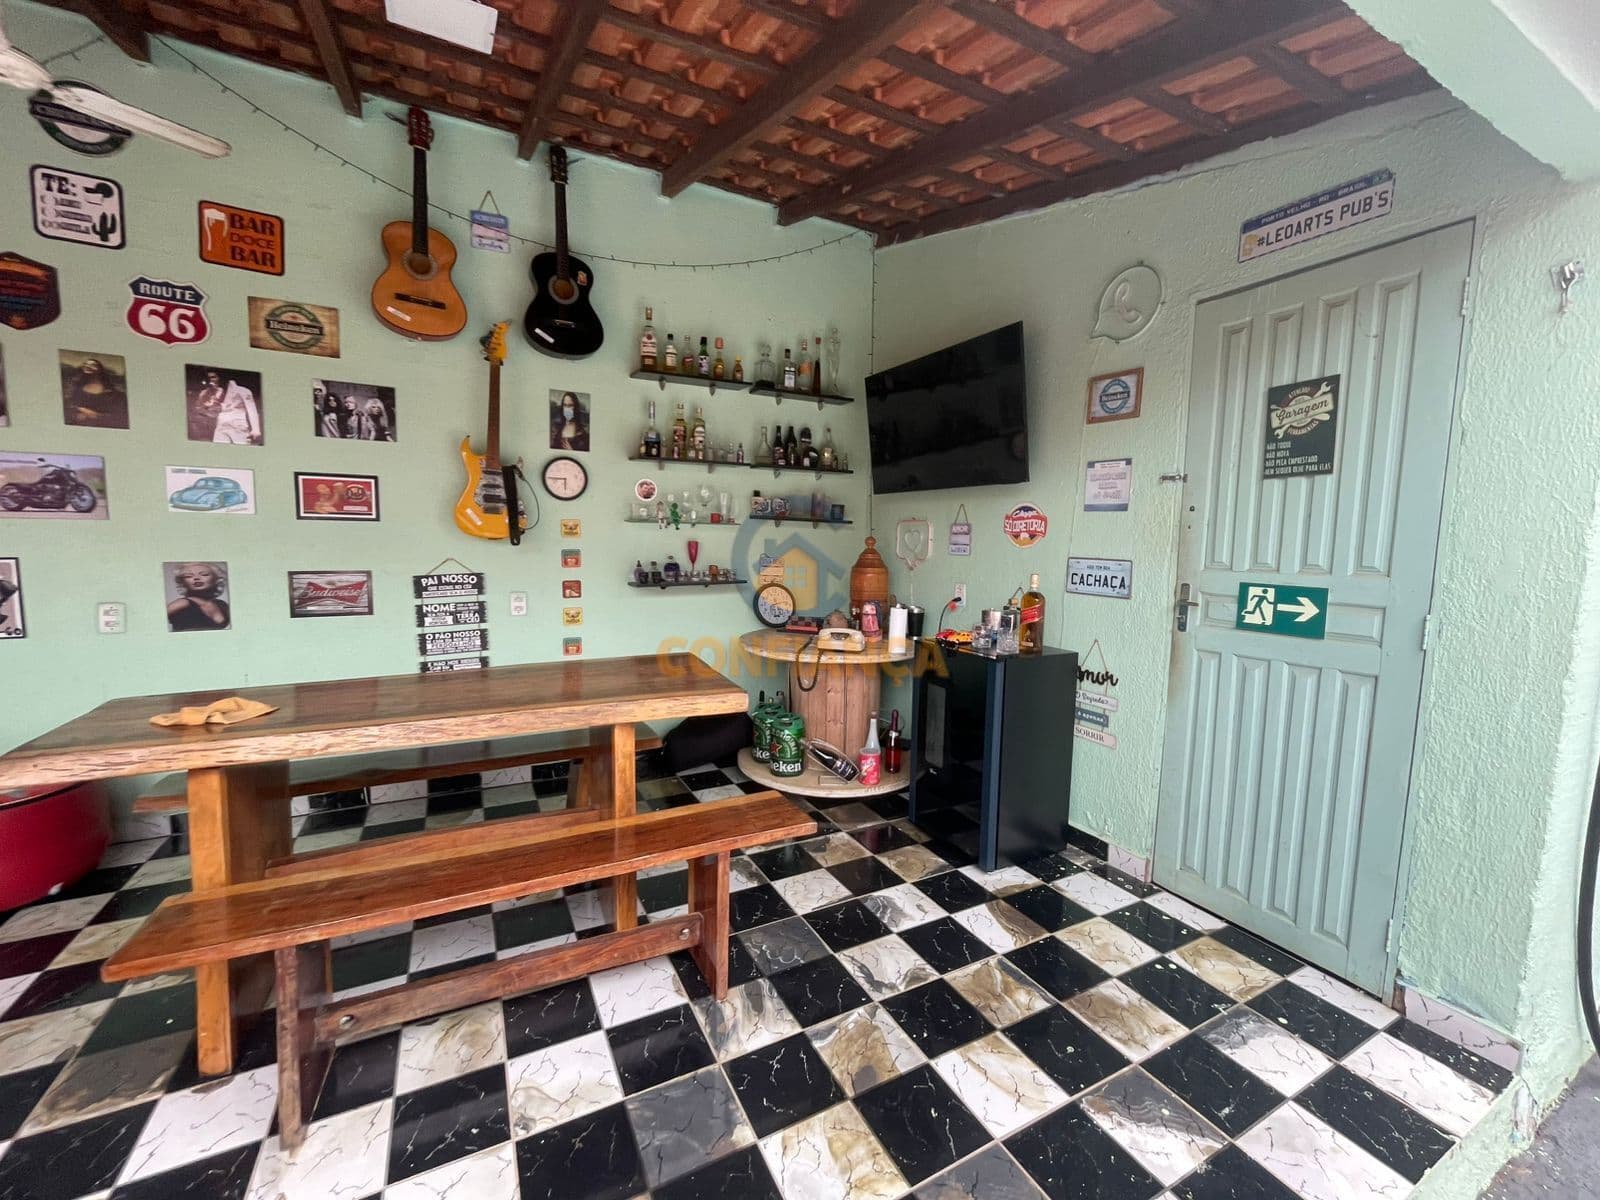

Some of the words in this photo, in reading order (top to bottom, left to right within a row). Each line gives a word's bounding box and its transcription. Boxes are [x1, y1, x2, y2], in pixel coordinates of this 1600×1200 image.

[1261, 211, 1284, 224] PORTO
[1286, 202, 1311, 215] VELHO
[1338, 183, 1368, 196] BRASIL
[230, 213, 275, 236] BAR
[1257, 210, 1334, 247] #LEOARTS
[1339, 190, 1389, 221] PUB'S
[230, 232, 275, 250] DOCE
[231, 246, 276, 268] BAR
[139, 282, 196, 302] ROUTE
[138, 303, 196, 340] 66
[1275, 399, 1329, 424] Garagem
[1288, 455, 1318, 465] EMPRESTADO
[421, 576, 438, 587] PAI
[441, 574, 478, 584] NOSSO
[1070, 572, 1126, 592] CACHAÇA
[422, 603, 457, 613] NOME
[453, 630, 481, 638] NOSSO
[1074, 726, 1105, 743] SORRIR
